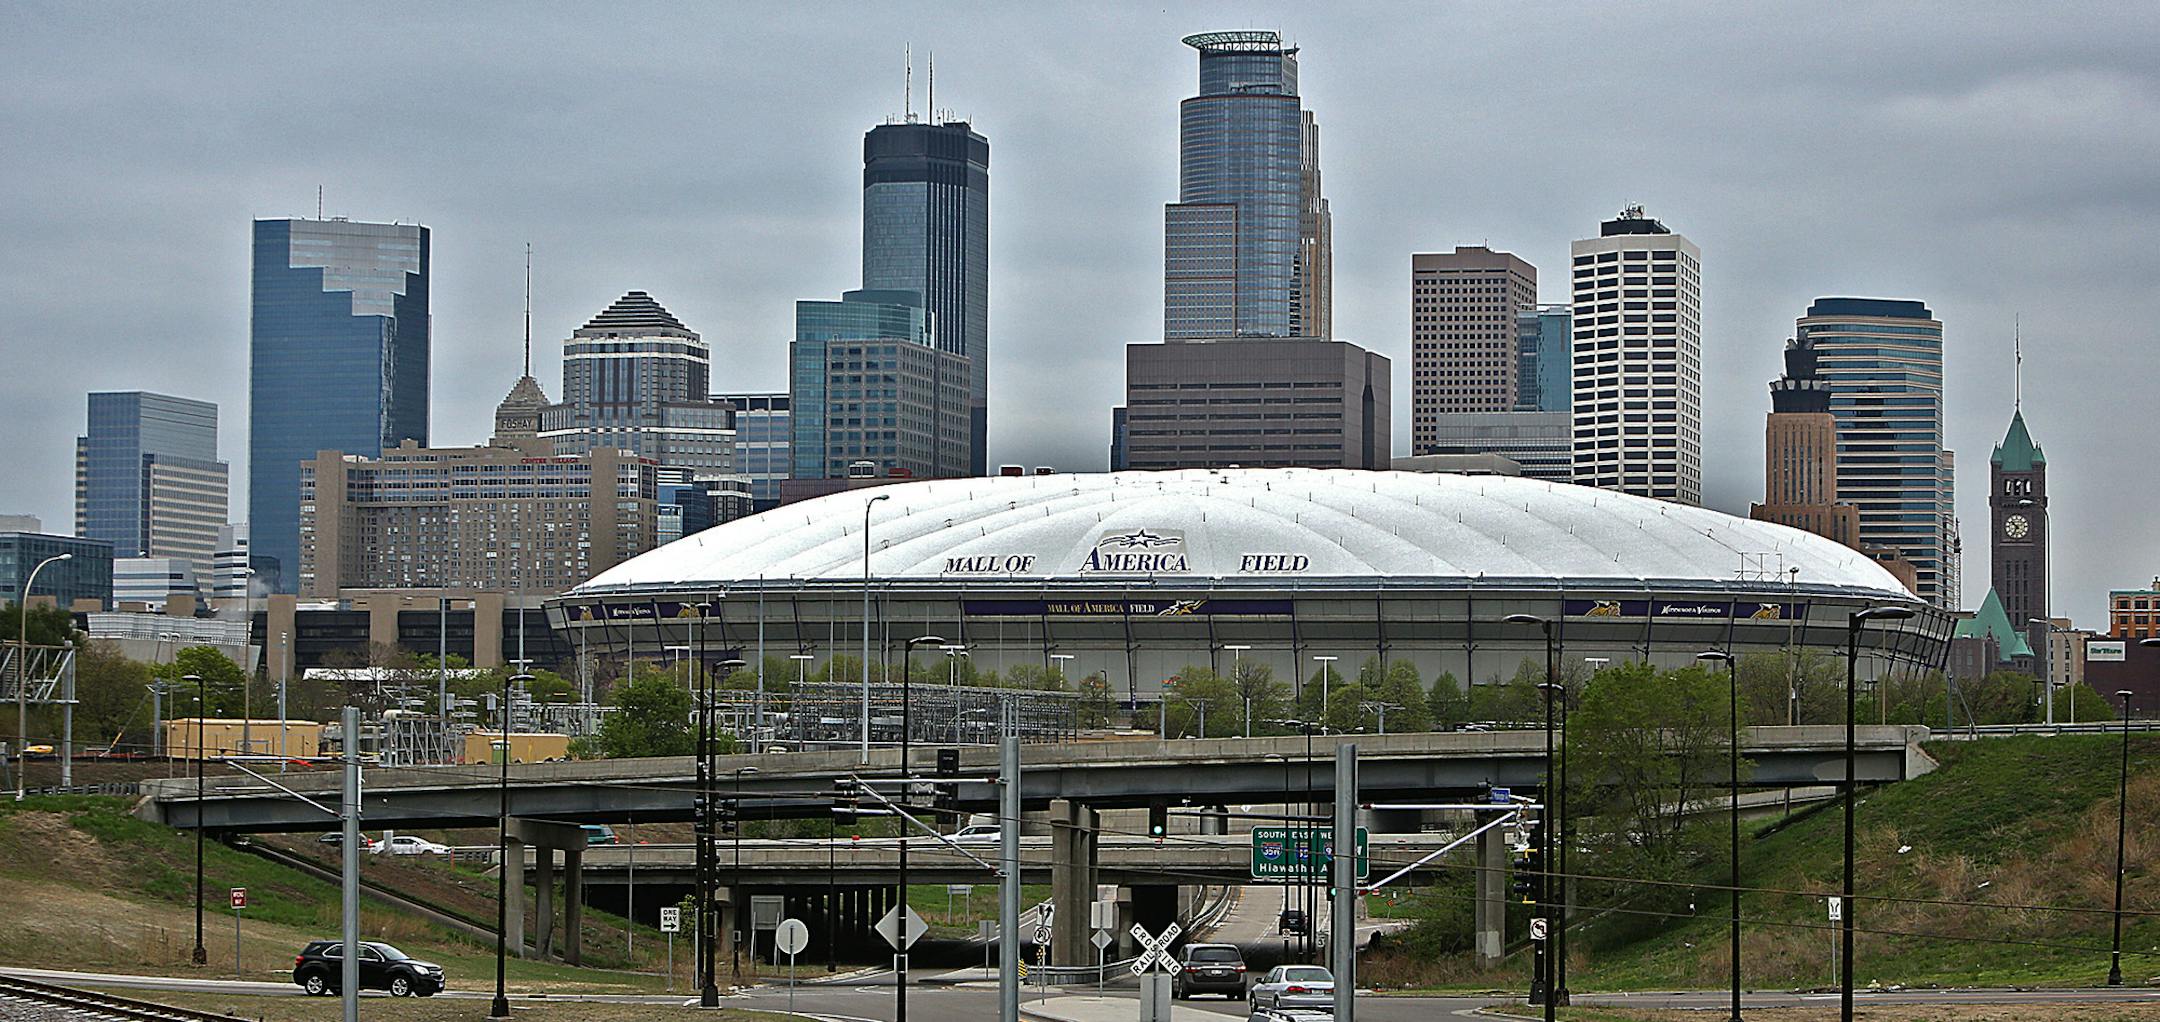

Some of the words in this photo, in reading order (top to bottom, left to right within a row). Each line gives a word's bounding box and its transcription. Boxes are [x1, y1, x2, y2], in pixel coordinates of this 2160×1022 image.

[943, 555, 1000, 573] MALL
[1005, 555, 1036, 572] OF
[1078, 546, 1187, 572] AMERICA
[1240, 554, 1309, 571] FIELD
[1047, 603, 1070, 613] MALL
[1070, 603, 1082, 613] OF
[1082, 601, 1125, 613] AMERICA
[1129, 603, 1155, 613] FIELD
[1257, 831, 1286, 839] SOUTH
[1133, 926, 1180, 974] CROSSING
